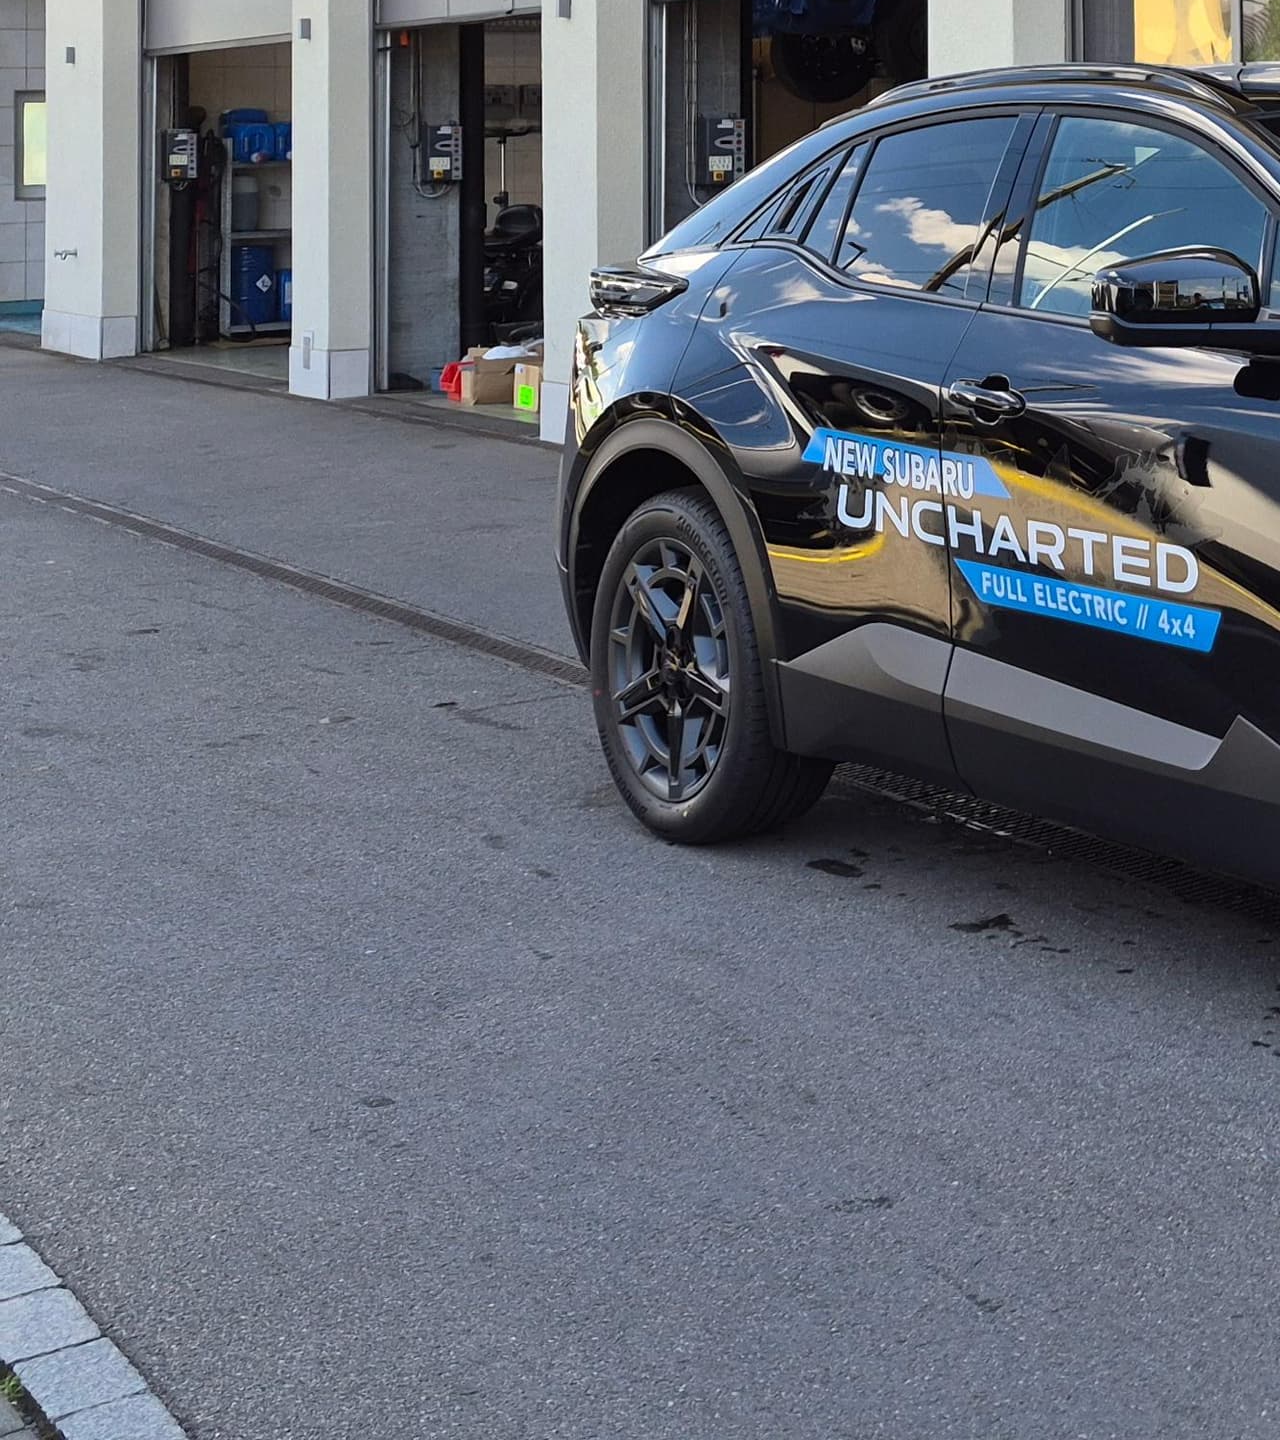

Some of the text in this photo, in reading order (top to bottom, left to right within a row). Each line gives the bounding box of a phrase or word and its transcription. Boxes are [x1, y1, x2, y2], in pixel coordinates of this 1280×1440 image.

[823, 435, 975, 500] NEW SUBARU
[836, 483, 1199, 594] UNCHARTED
[981, 571, 1028, 604] FULL
[1034, 577, 1127, 626] ELECTRIC
[1157, 608, 1197, 640] 4x4
